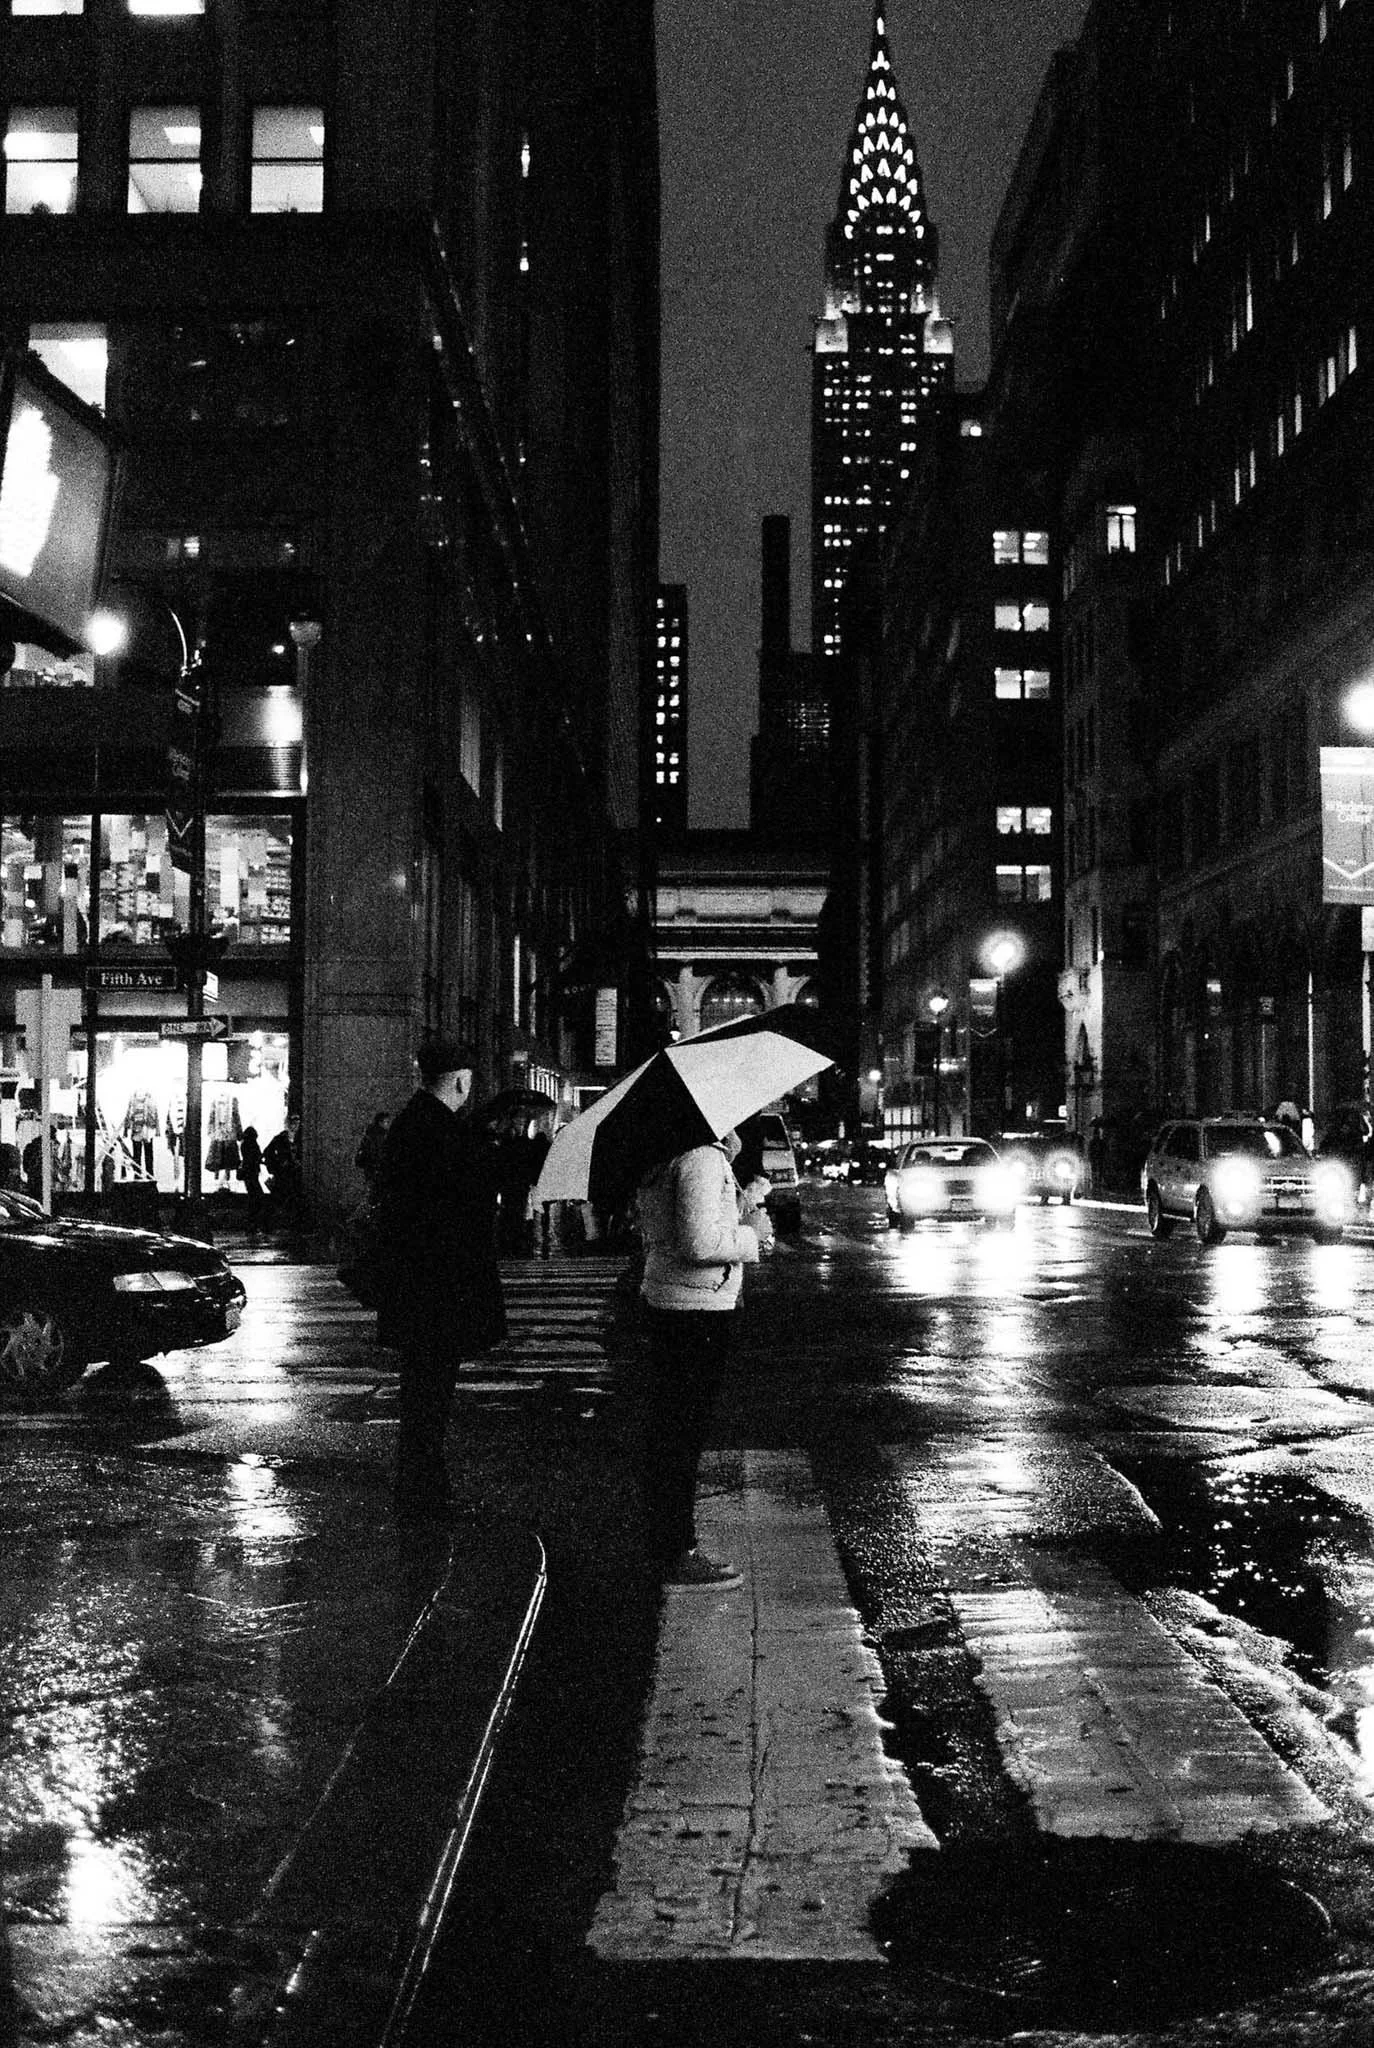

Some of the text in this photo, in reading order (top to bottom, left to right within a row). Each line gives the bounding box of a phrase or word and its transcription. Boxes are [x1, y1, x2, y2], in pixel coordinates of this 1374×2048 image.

[101, 972, 163, 985] Fifth Ave
[163, 1021, 217, 1034] ONE WAY
